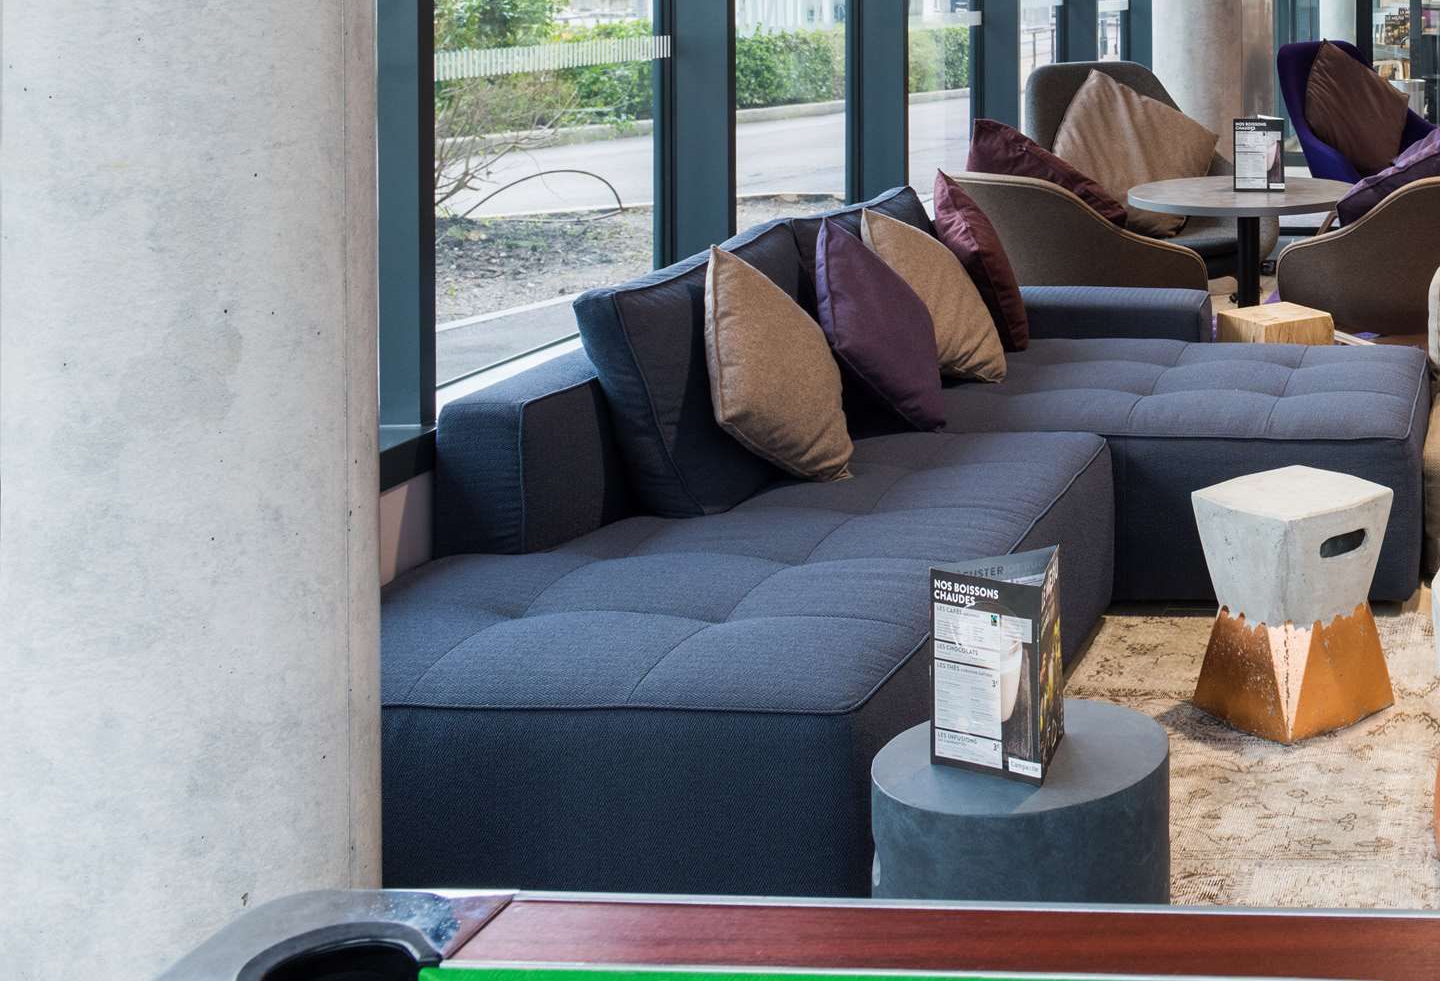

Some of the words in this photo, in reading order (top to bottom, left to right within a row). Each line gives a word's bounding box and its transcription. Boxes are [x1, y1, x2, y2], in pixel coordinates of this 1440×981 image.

[934, 579, 952, 591] NOS
[954, 583, 999, 599] BOISSONS
[934, 590, 976, 605] CHAUDES
